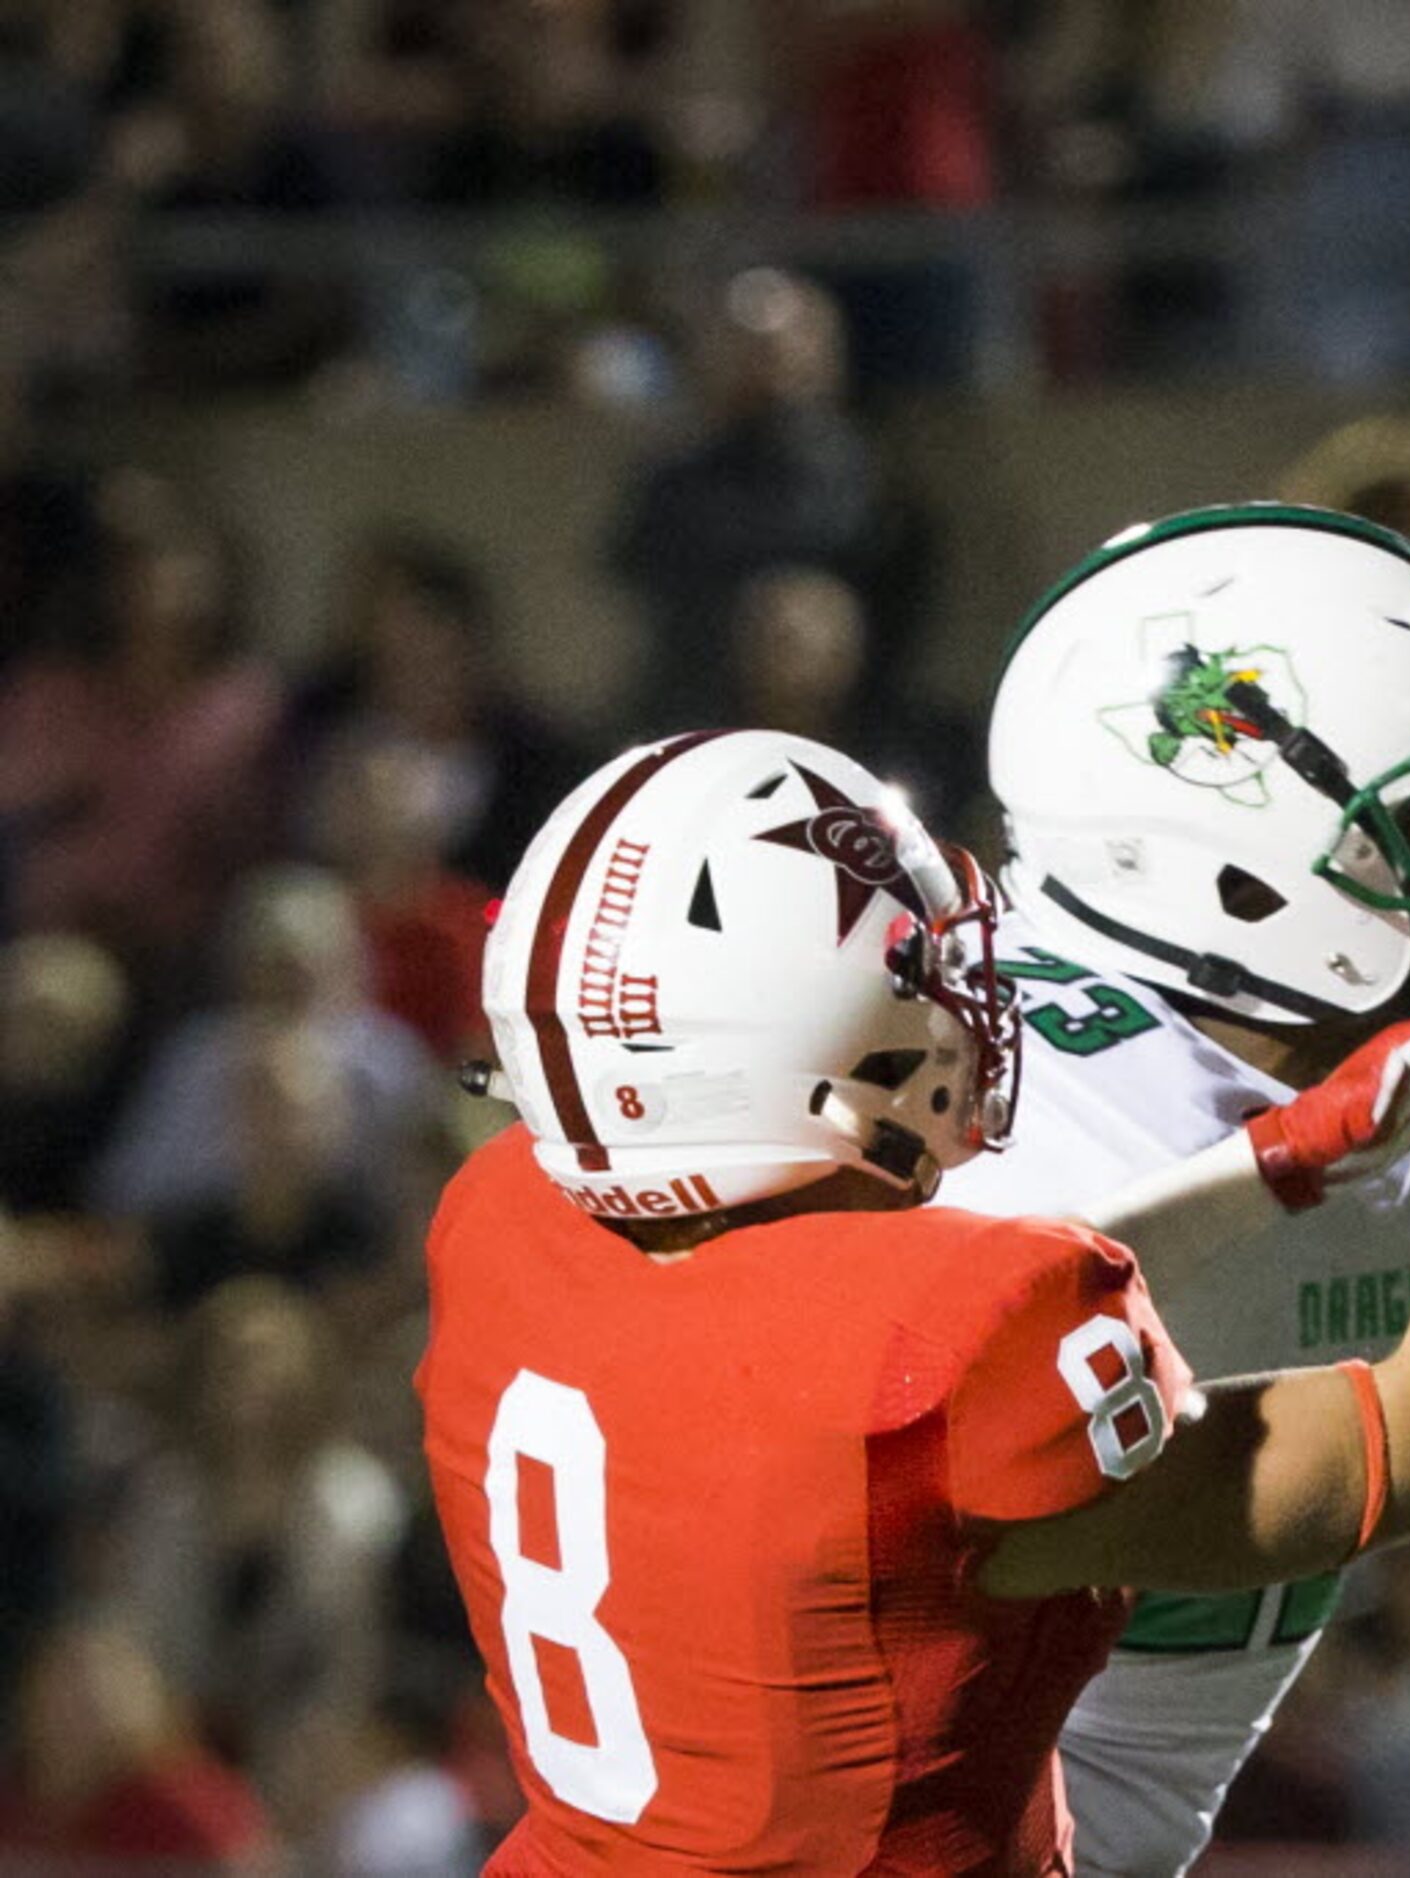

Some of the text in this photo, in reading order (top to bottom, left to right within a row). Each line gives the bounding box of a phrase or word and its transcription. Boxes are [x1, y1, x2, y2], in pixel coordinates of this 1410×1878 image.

[615, 1085, 645, 1120] 8
[1057, 1314, 1166, 1480] 8
[484, 1367, 659, 1825] 8
